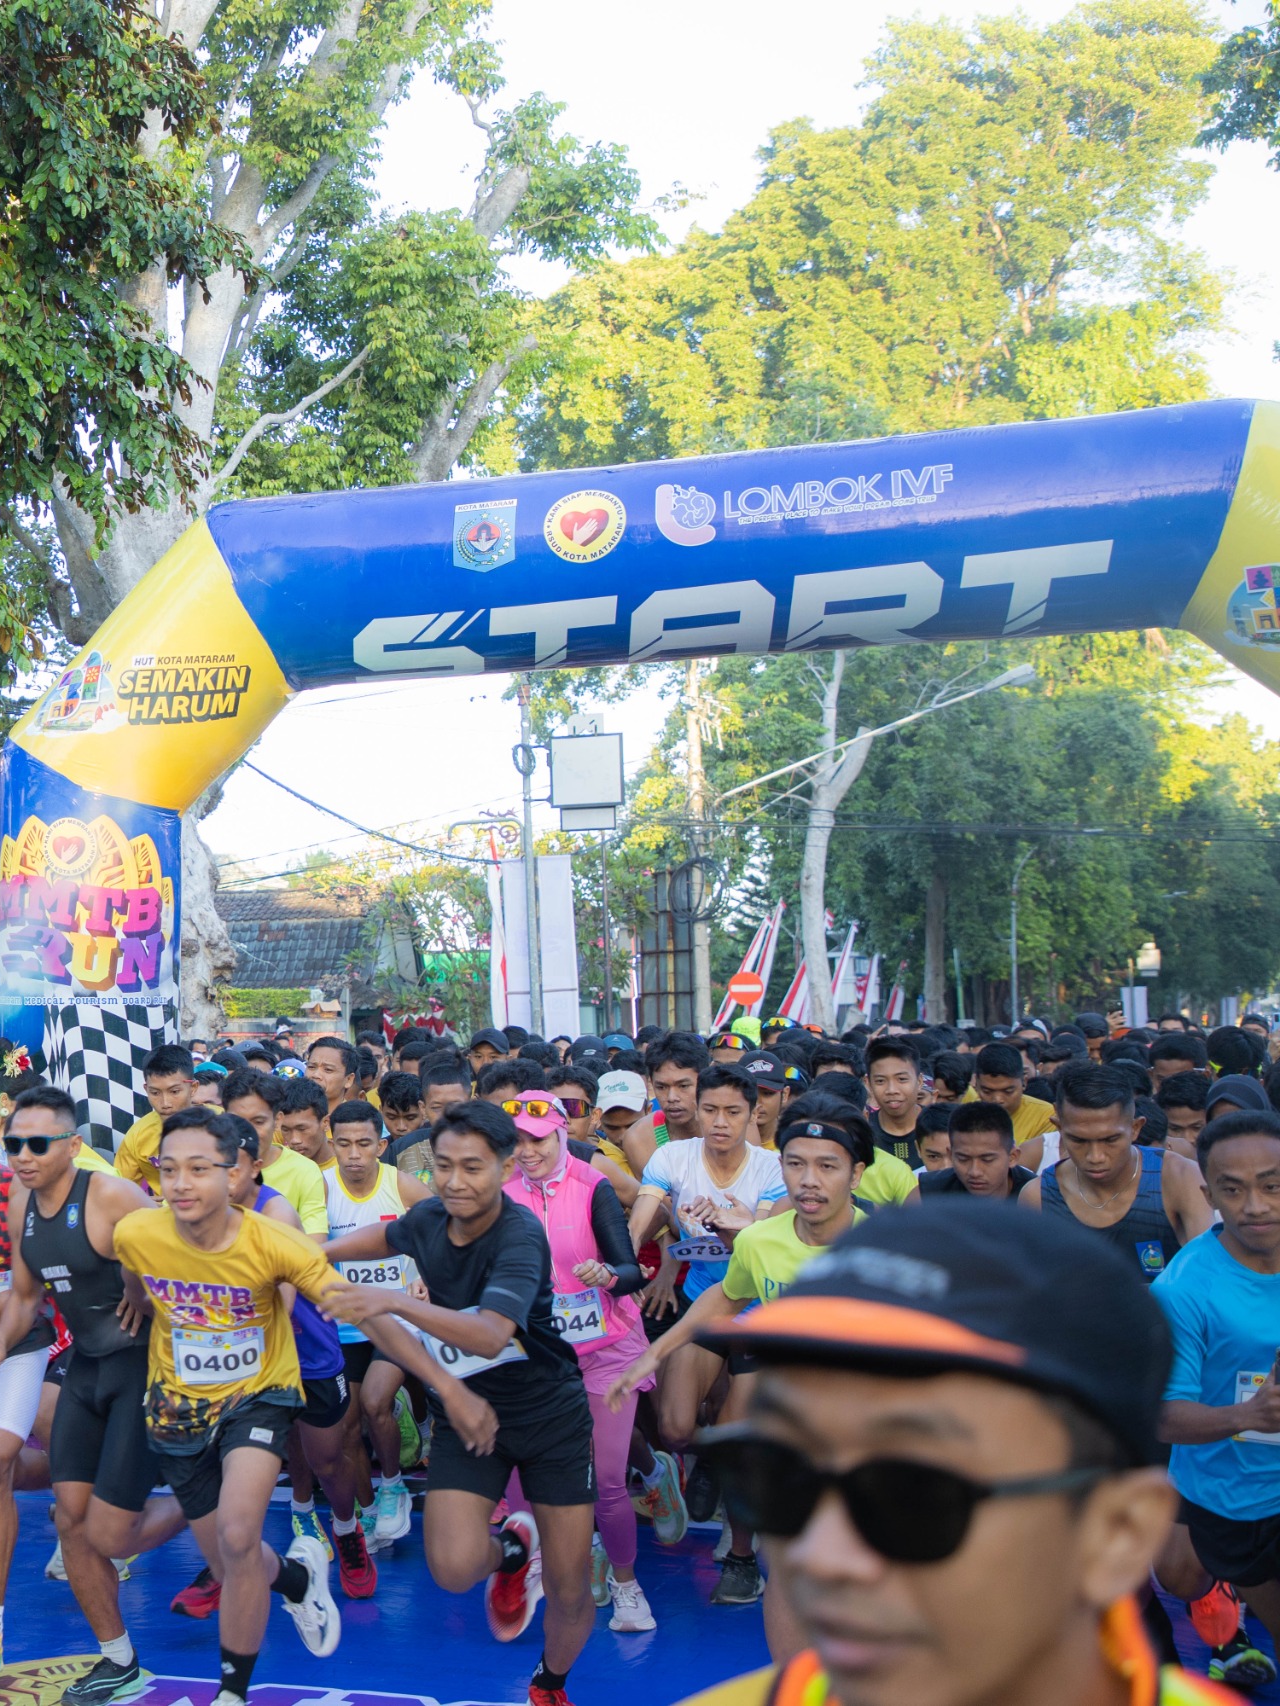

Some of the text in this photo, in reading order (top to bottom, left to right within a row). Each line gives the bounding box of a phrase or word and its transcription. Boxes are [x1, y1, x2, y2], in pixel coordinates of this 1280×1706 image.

[458, 500, 514, 511] KOTA MATARAM
[724, 463, 953, 518] LOMBOK IVF
[548, 491, 623, 523] KAMI SIAP MEMBANTU
[547, 522, 623, 561] RSUD KOTA MATARAM
[353, 539, 1113, 682] START
[134, 654, 235, 666] HUT KOTA MATARAM
[118, 665, 250, 696] SEMAKIN
[128, 691, 239, 724] HARUM
[1, 925, 164, 993] RUN
[346, 1265, 400, 1284] 0283
[142, 1275, 251, 1307] MMTB
[171, 1302, 257, 1325] RUN
[184, 1347, 258, 1372] 0400
